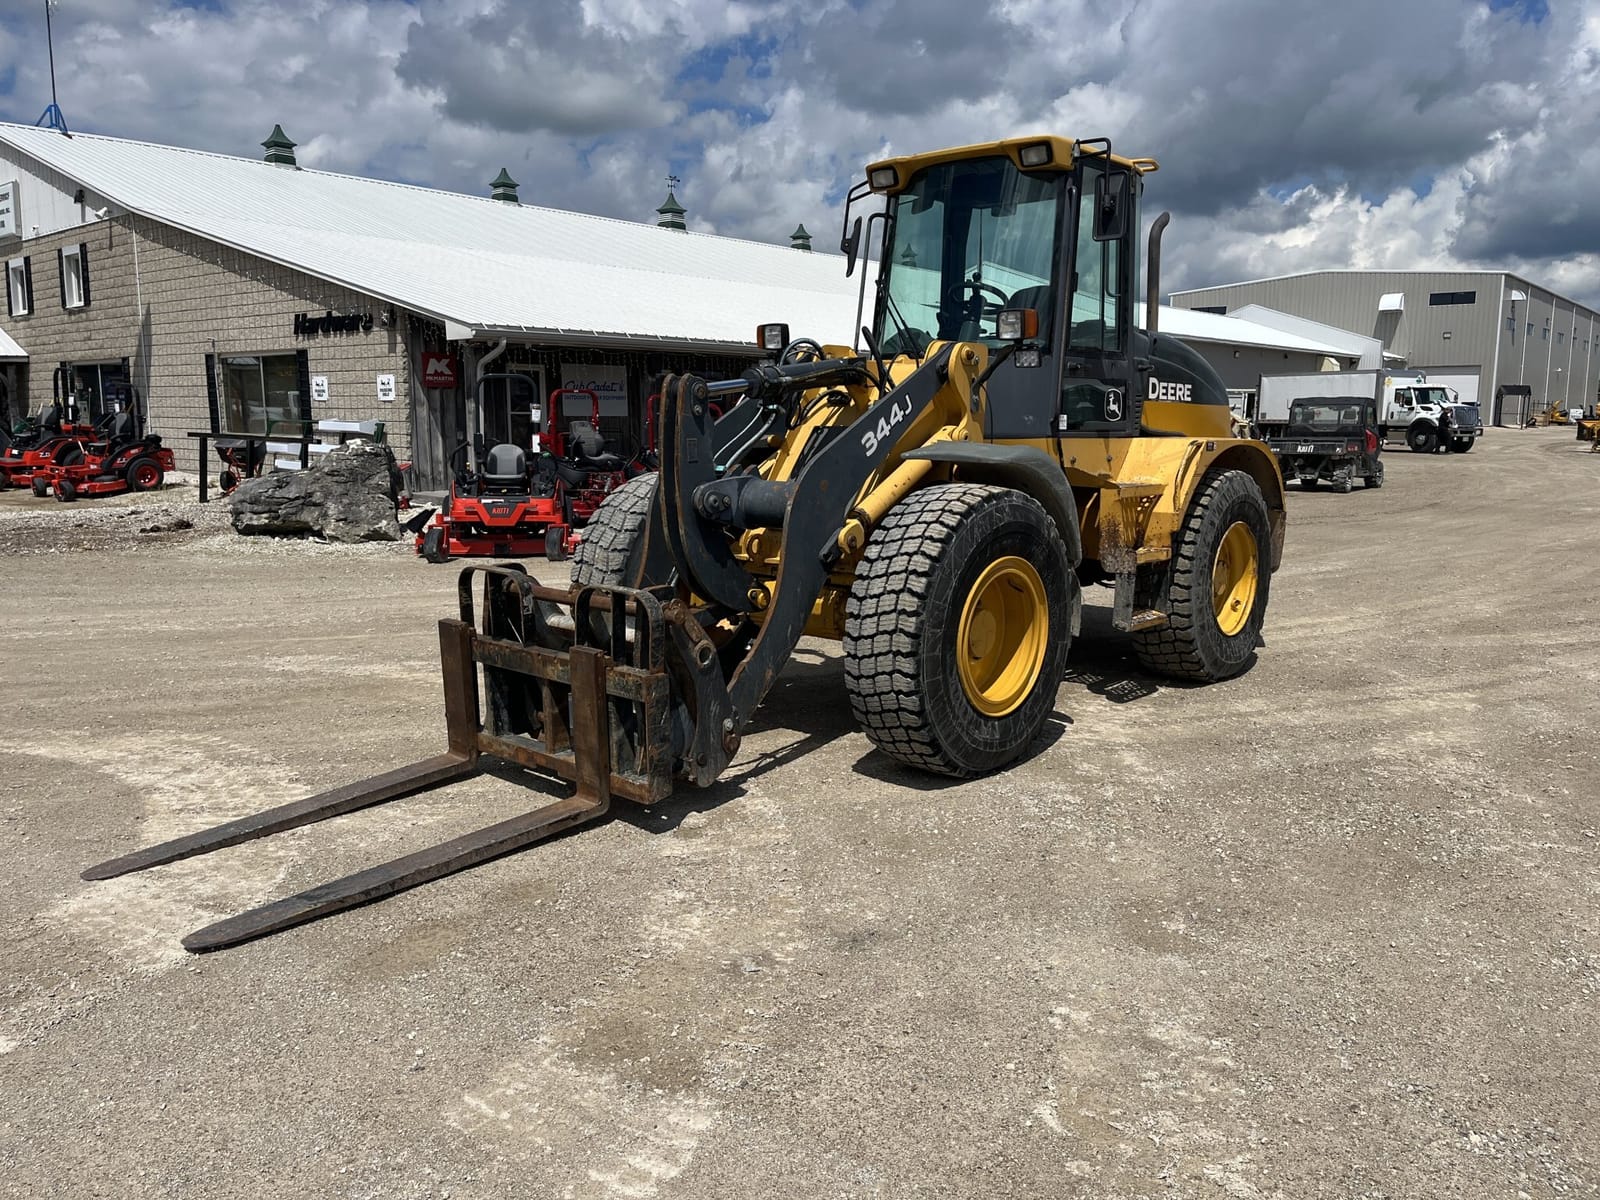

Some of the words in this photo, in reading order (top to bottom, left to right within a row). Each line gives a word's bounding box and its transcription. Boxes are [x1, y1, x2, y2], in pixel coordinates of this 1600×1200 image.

[293, 310, 374, 335] Hardware
[564, 380, 585, 390] Cub
[586, 380, 617, 392] Cadet
[1148, 376, 1193, 402] DEERE
[861, 394, 913, 457] 344J
